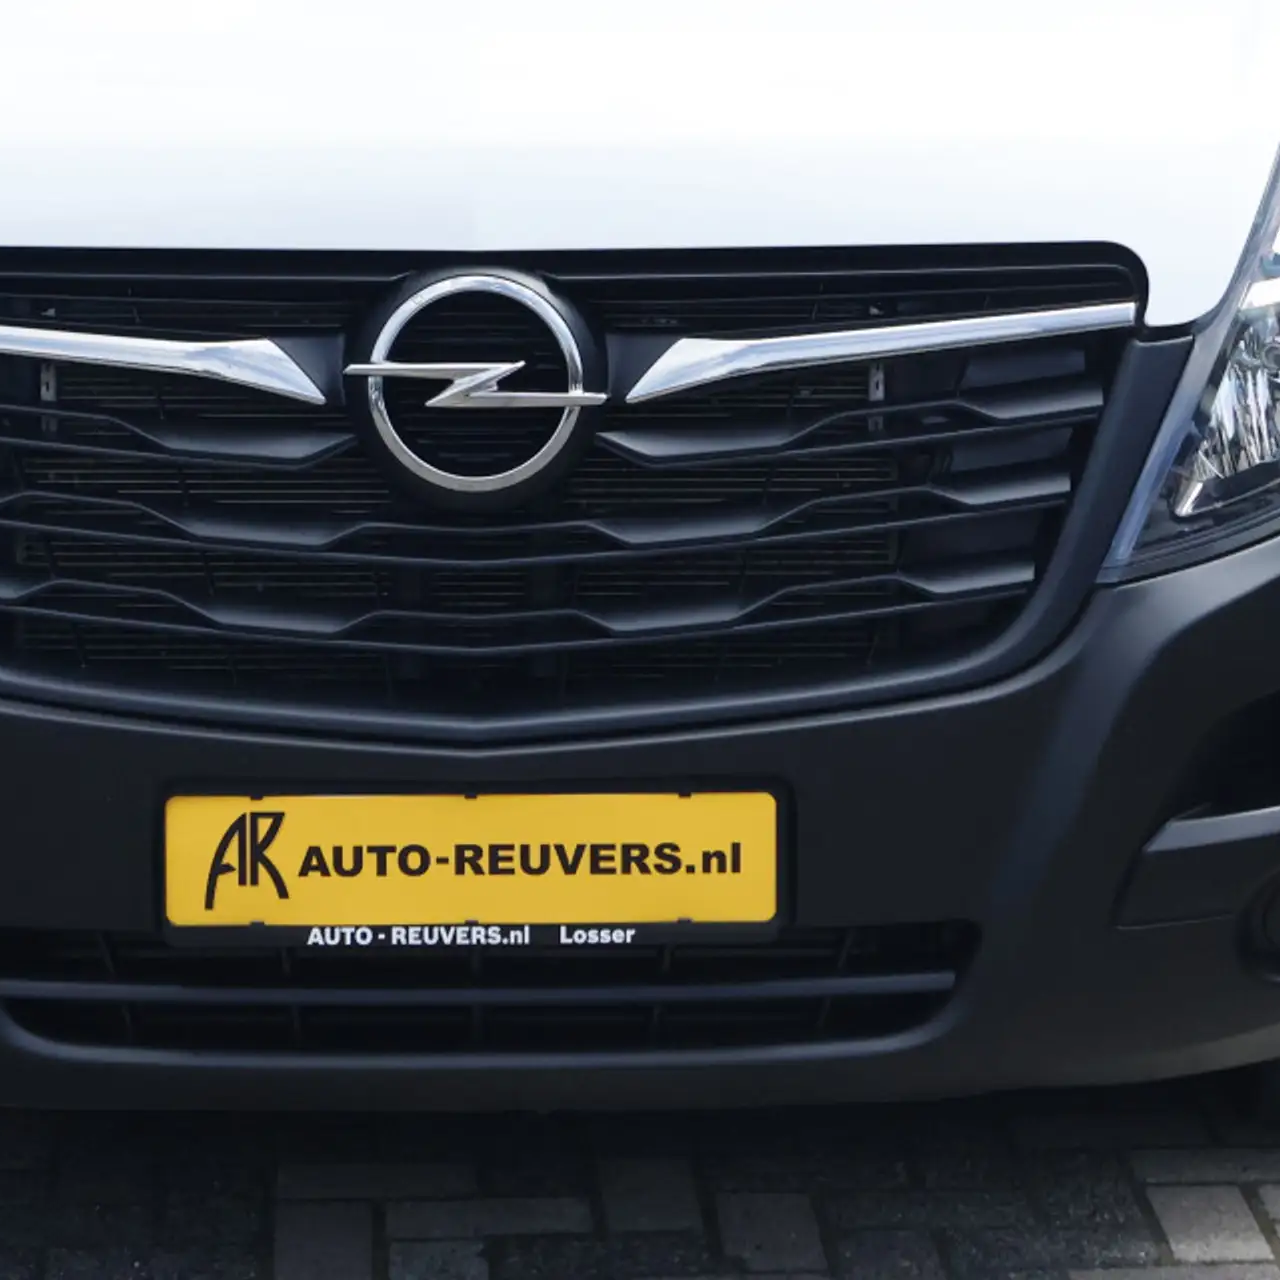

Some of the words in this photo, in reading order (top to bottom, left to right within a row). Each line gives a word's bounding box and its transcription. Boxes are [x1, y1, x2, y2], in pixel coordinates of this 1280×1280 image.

[298, 842, 741, 877] AUTO-REUVERS.nl
[307, 926, 373, 946] AUTO
[391, 924, 530, 946] REUVERS.nl
[559, 925, 636, 945] Losser
